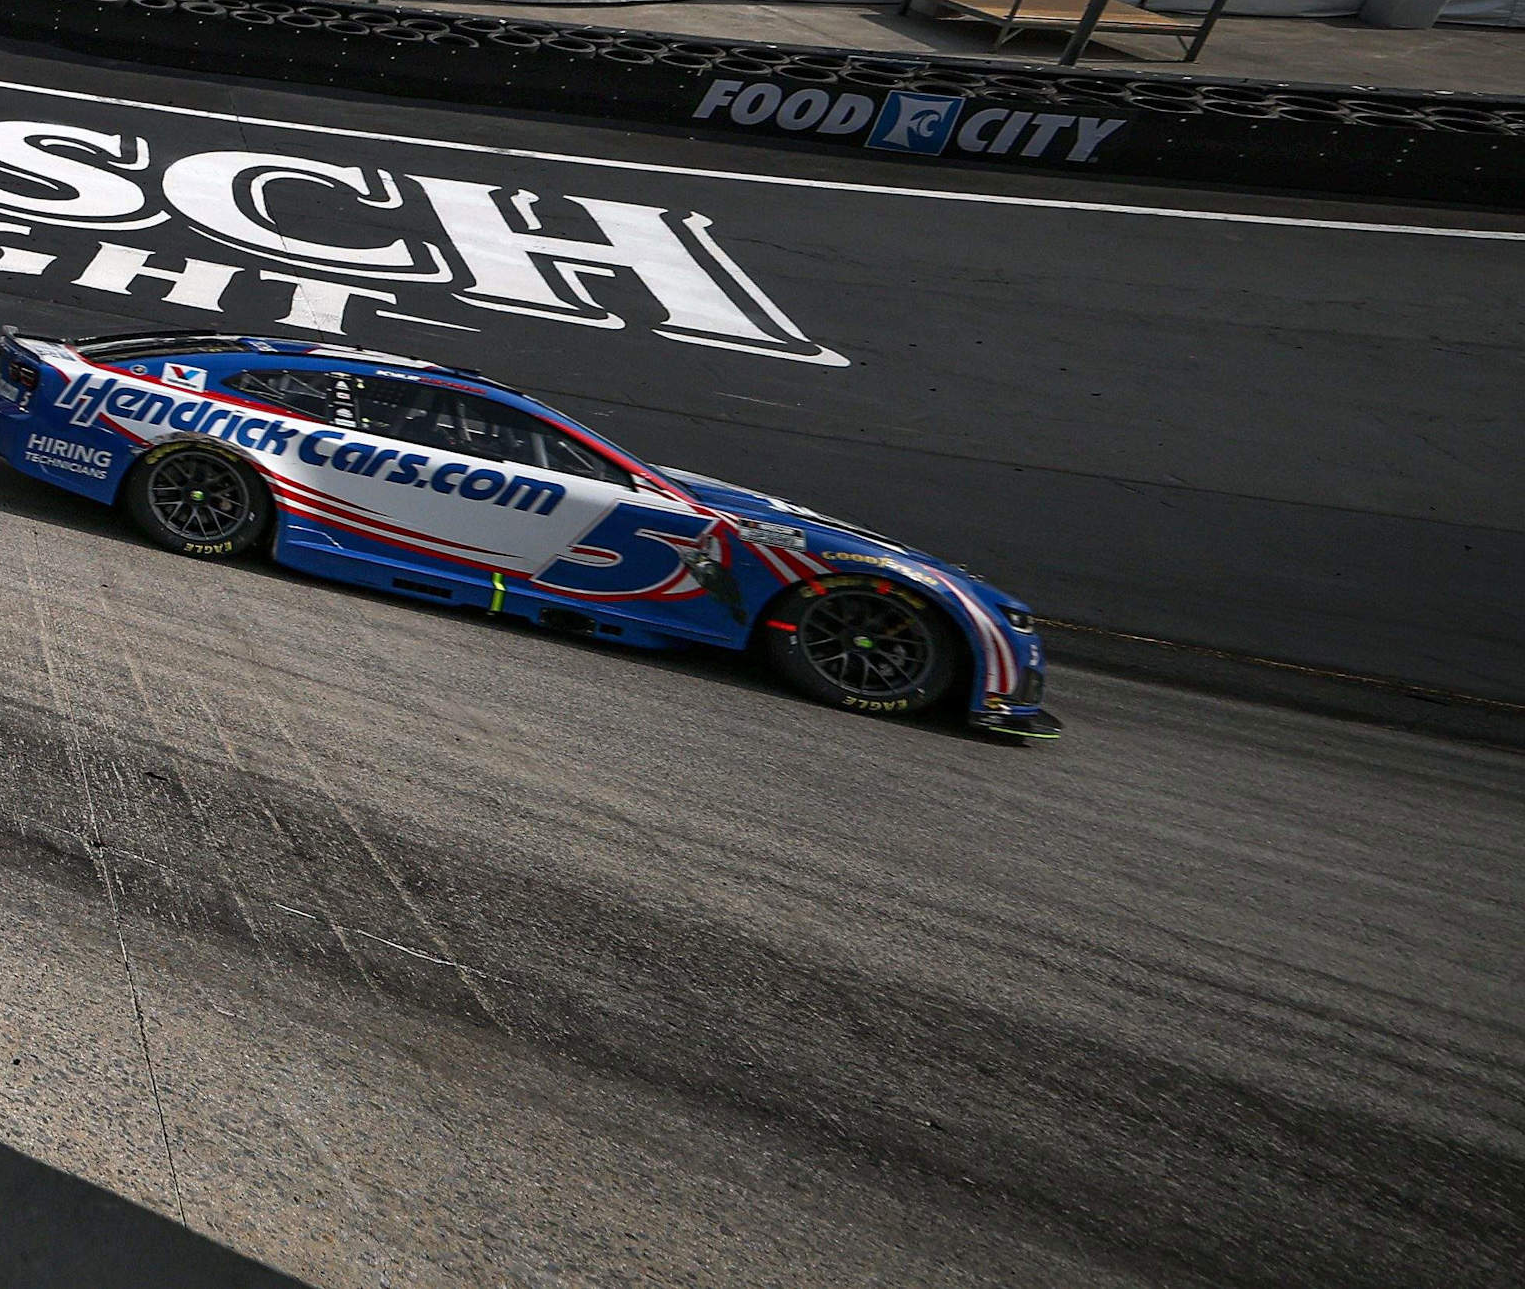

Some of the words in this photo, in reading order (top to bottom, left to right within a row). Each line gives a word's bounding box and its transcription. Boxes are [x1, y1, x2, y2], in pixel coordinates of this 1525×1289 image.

[693, 78, 877, 135] FOOD
[957, 107, 1127, 163] CITY
[19, 391, 30, 406] 5
[28, 433, 113, 469] HIRING
[54, 373, 567, 516] HendrickCars.com
[25, 451, 108, 481] TECHNICIANS
[183, 540, 233, 556] EAGLE
[532, 499, 724, 603] 5
[821, 550, 939, 587] GOODYEAR
[843, 695, 908, 712] EAGLE
